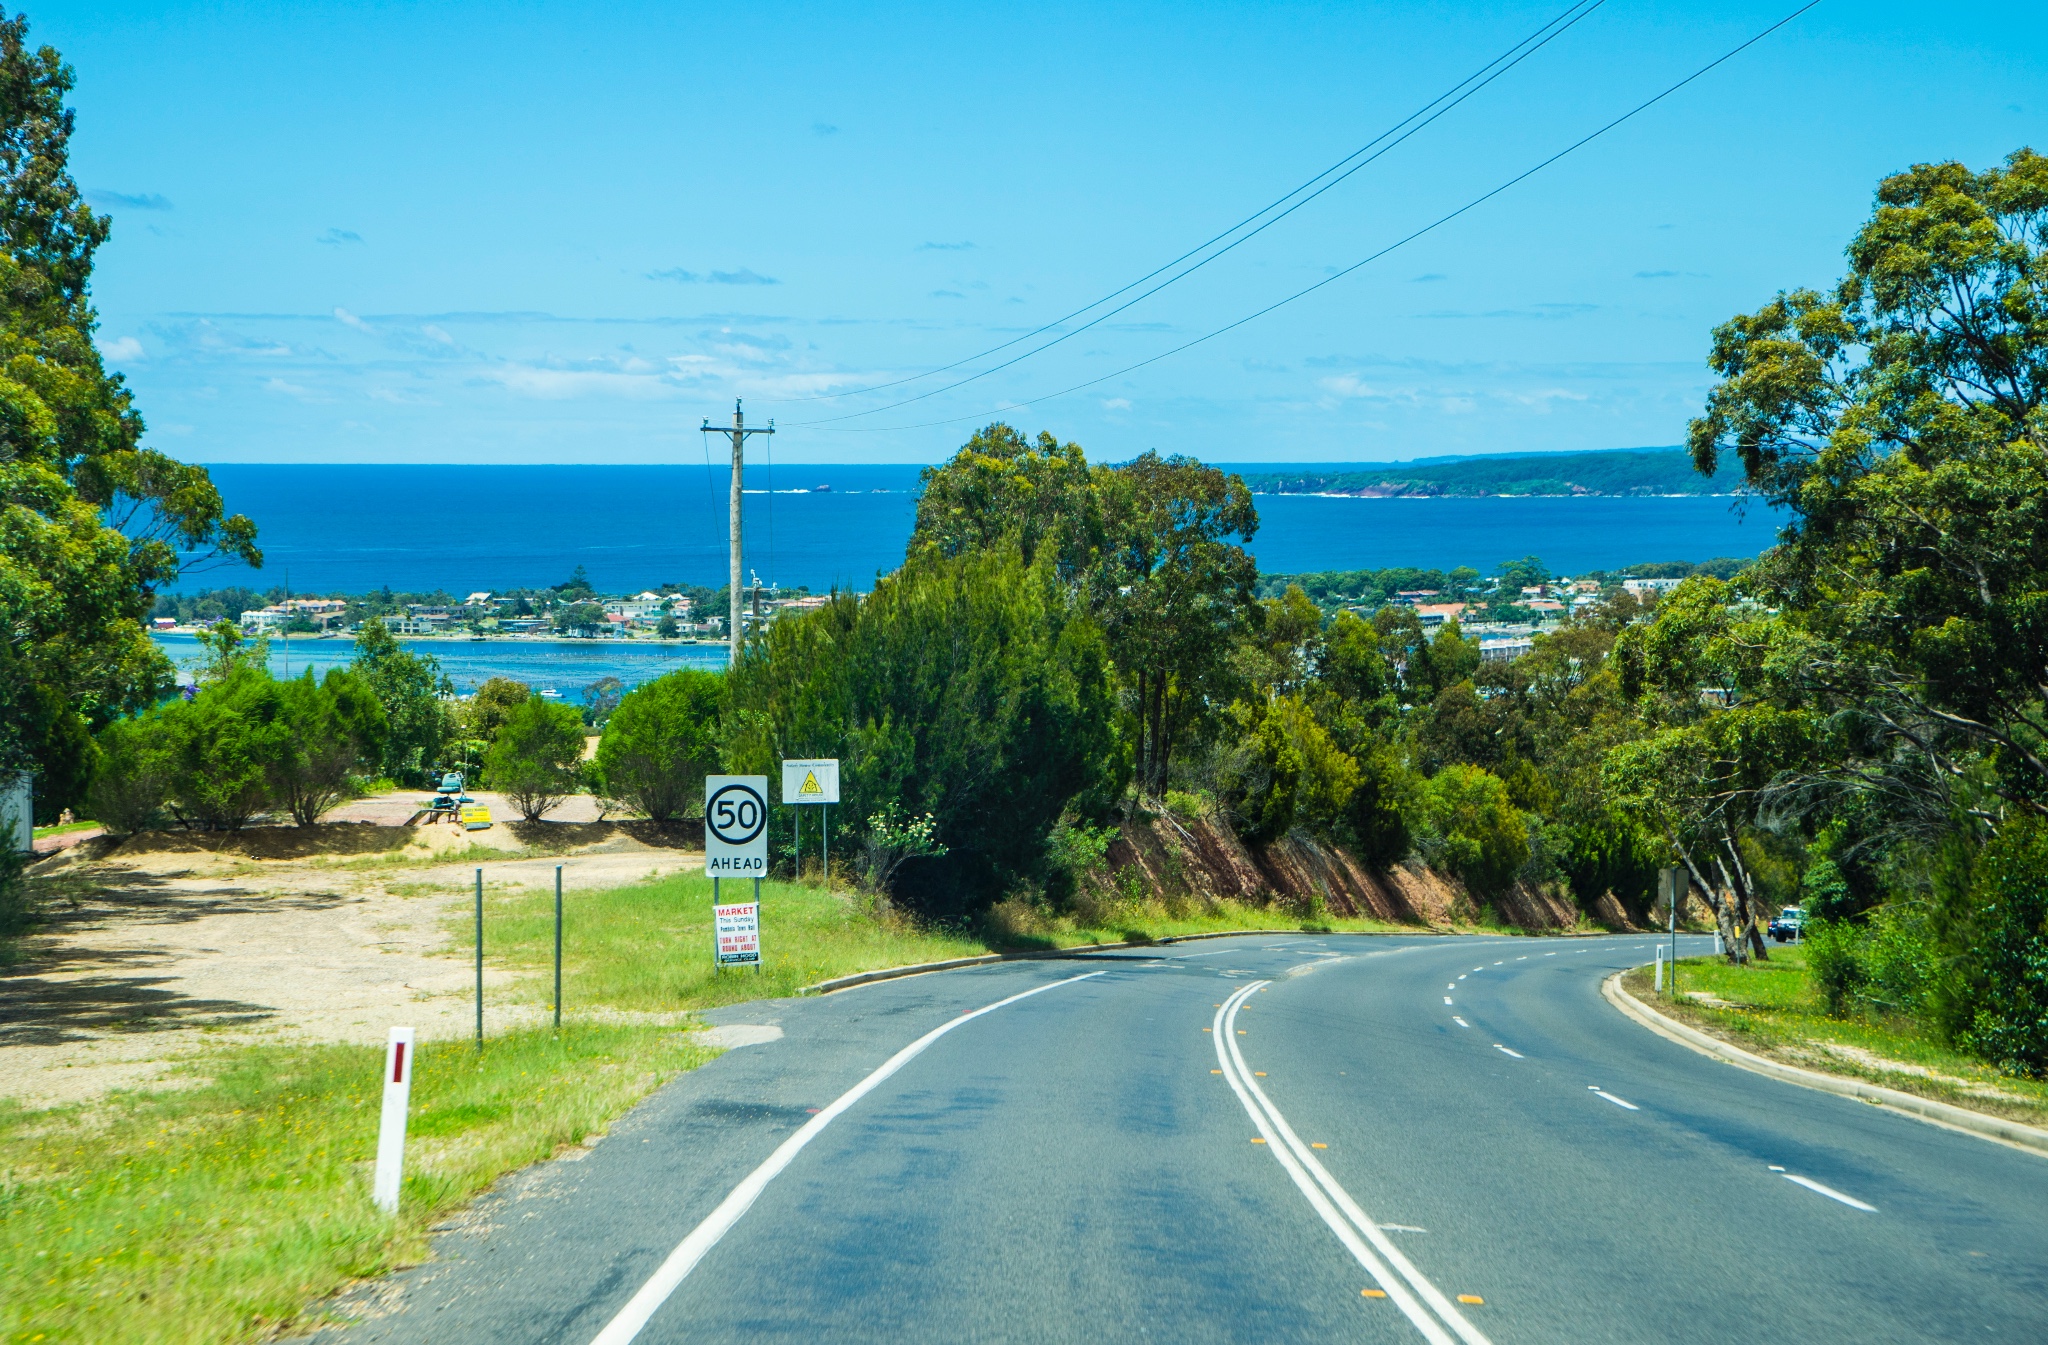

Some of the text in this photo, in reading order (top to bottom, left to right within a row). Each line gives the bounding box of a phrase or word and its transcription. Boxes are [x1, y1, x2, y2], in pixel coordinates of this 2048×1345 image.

[717, 800, 757, 829] 50
[711, 857, 762, 870] AHEAD
[718, 907, 753, 916] MARKET
[741, 943, 756, 951] ABOUT
